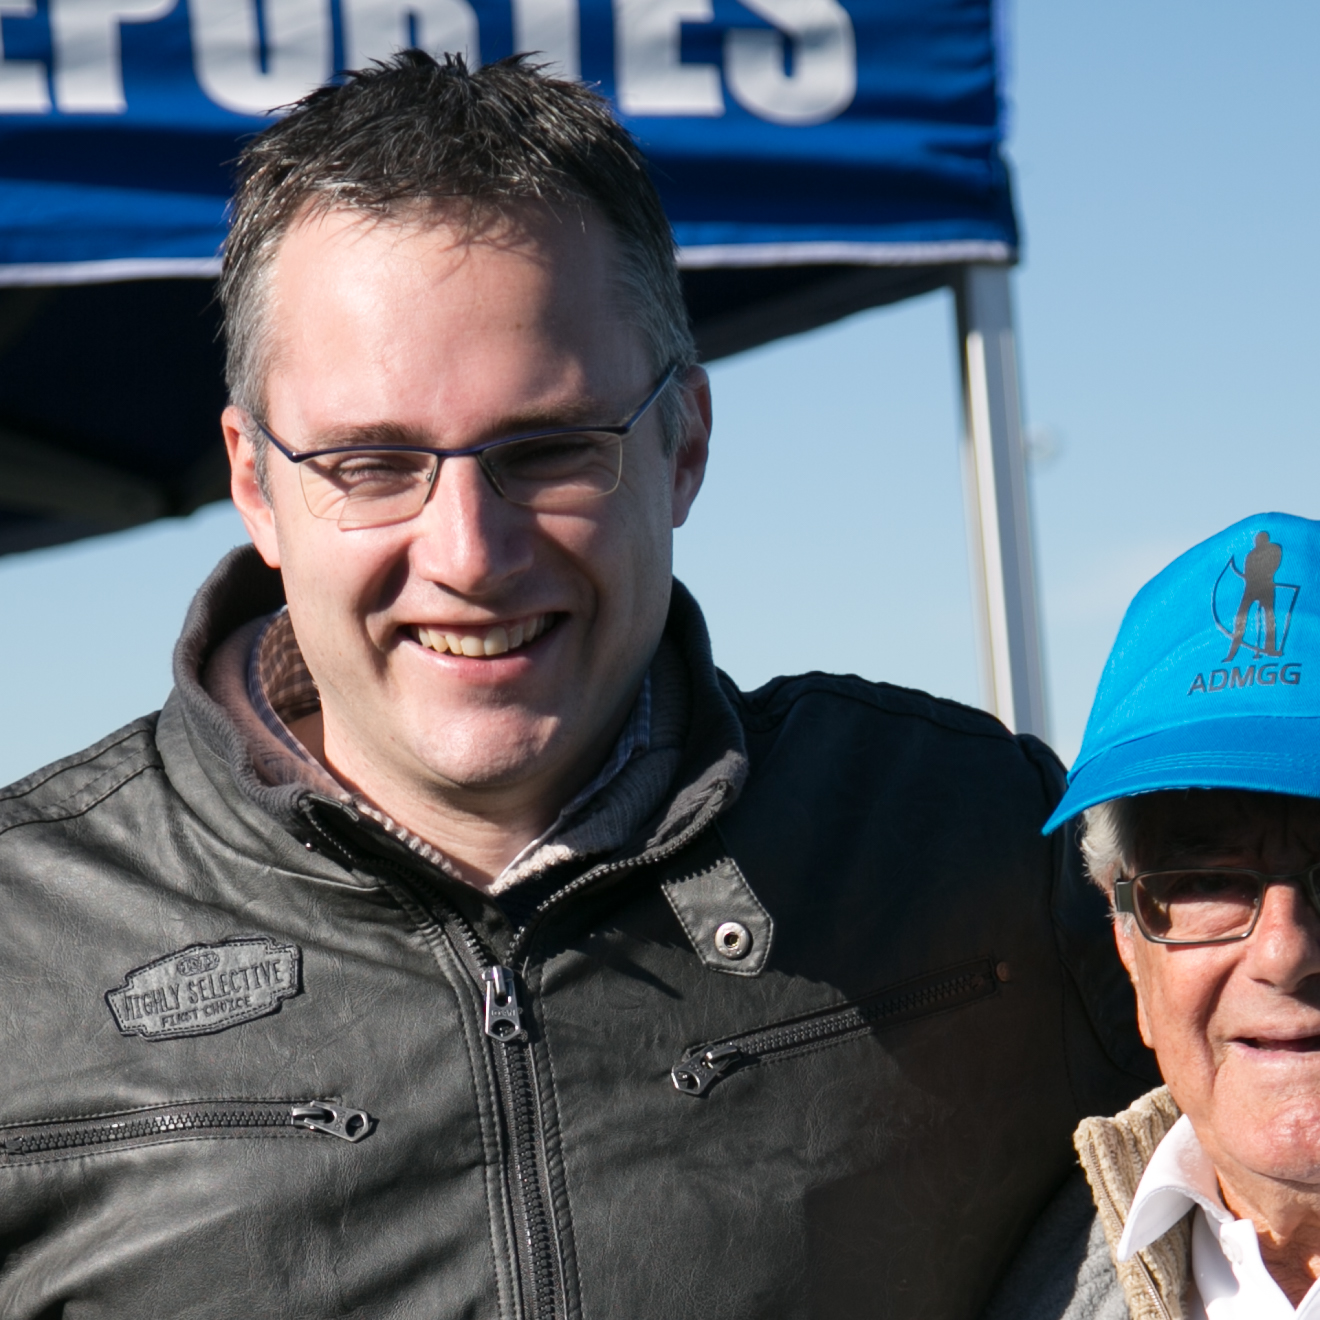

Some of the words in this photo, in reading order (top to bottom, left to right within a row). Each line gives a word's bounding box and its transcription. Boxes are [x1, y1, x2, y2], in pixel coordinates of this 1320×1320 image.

[1187, 662, 1302, 696] ADMGG
[122, 983, 180, 1021] HIGHLY
[188, 960, 283, 1004] SELECTIVE
[161, 1008, 199, 1028] FIRST
[204, 996, 253, 1018] CHOICE
